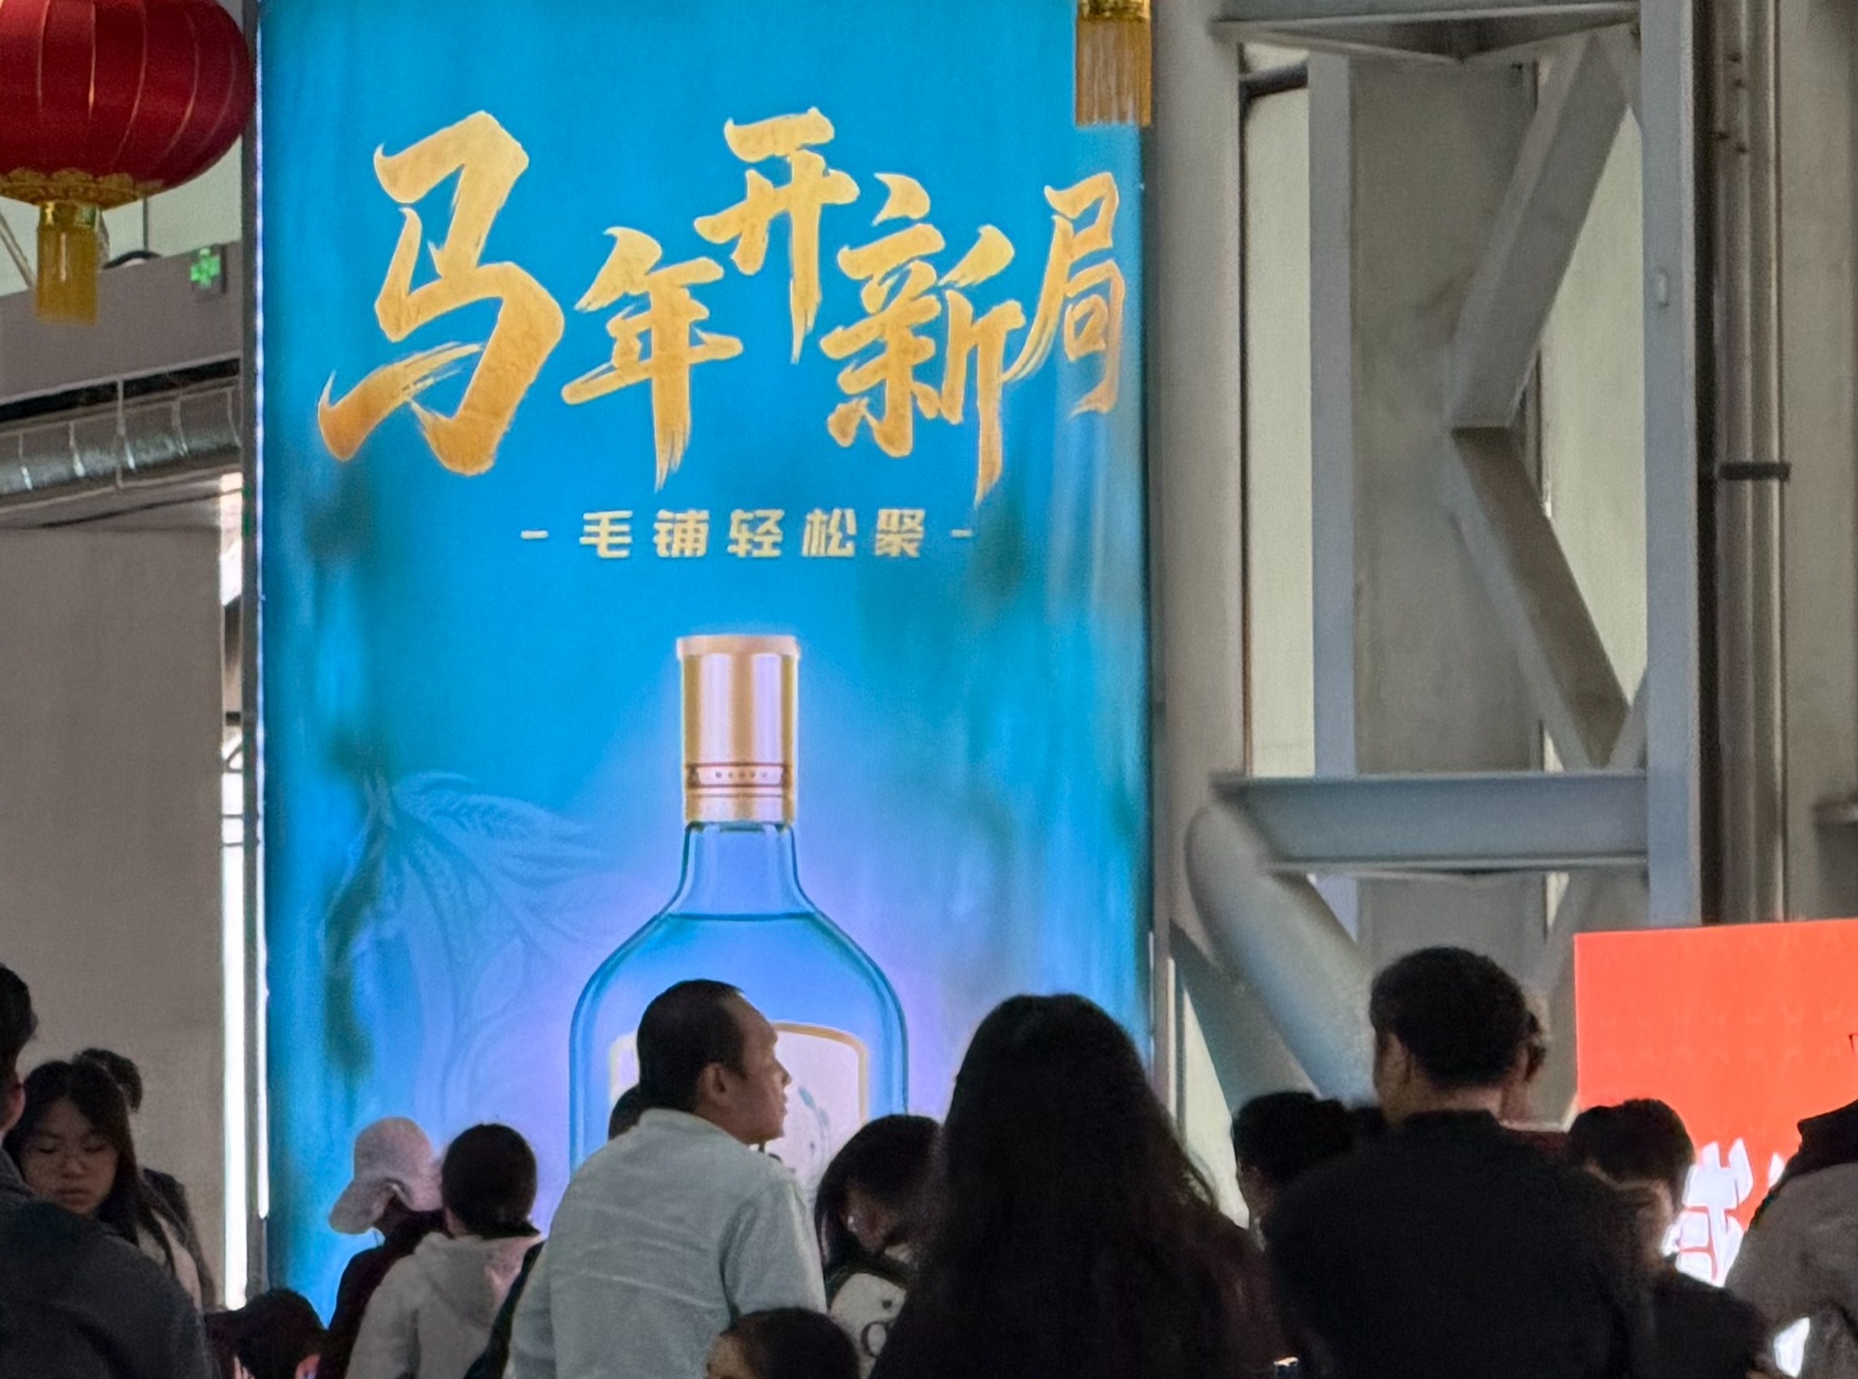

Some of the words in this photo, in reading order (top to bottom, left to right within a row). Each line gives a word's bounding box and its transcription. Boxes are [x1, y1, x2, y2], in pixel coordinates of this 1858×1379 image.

[317, 107, 1126, 504] 马年开新局
[579, 508, 927, 558] 毛铺轻松聚
